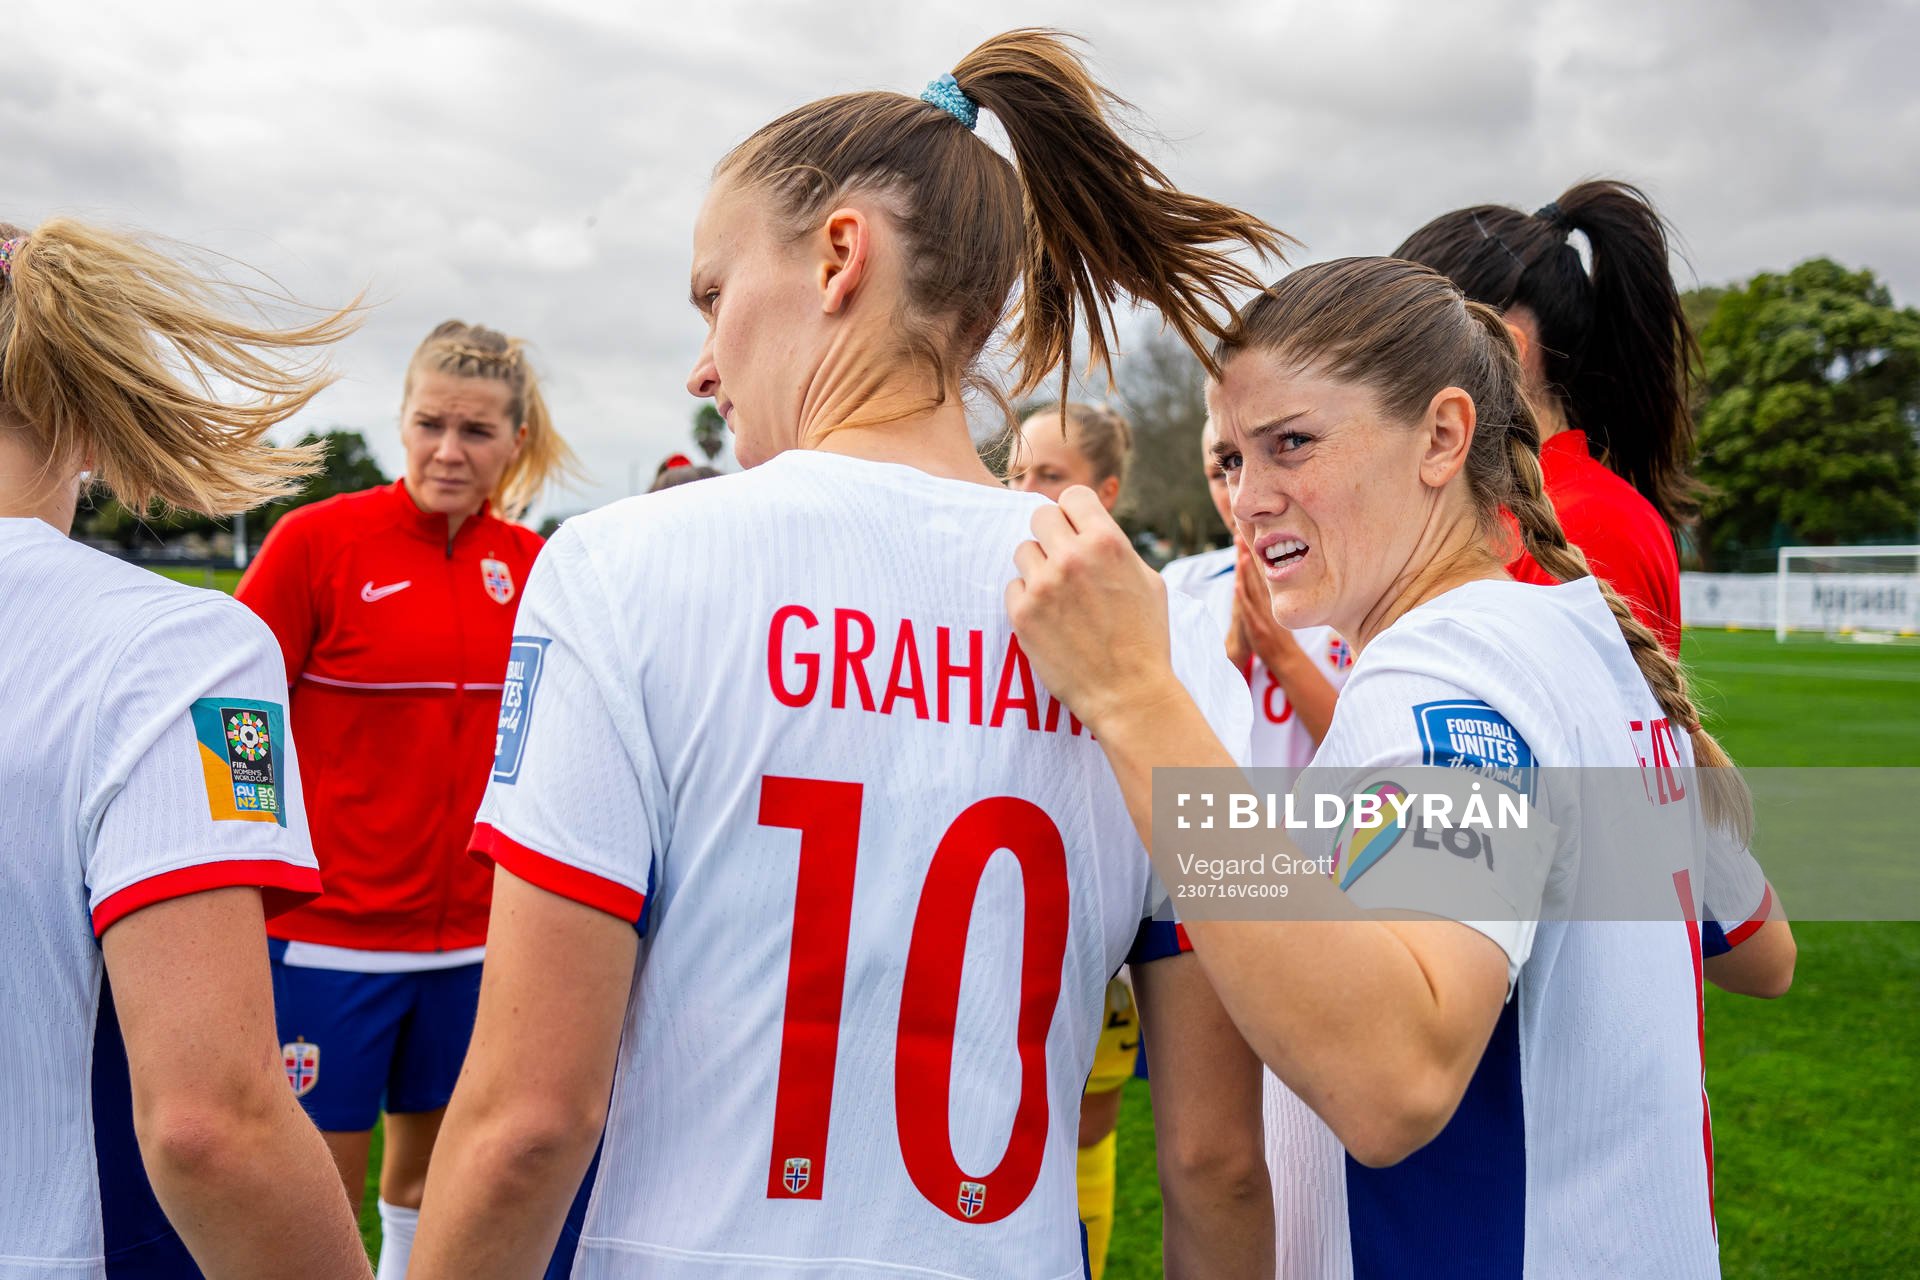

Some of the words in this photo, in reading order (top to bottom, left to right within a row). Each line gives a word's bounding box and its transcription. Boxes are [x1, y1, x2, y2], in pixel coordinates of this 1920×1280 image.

[767, 604, 1100, 740] GRAHA
[1446, 718, 1516, 742] FOOTBALL
[1450, 733, 1519, 766] UNITES
[232, 761, 248, 769] FIFA
[1480, 758, 1523, 791] World
[236, 786, 255, 797] AU
[238, 797, 259, 808] NZ
[758, 774, 1070, 1224] 10
